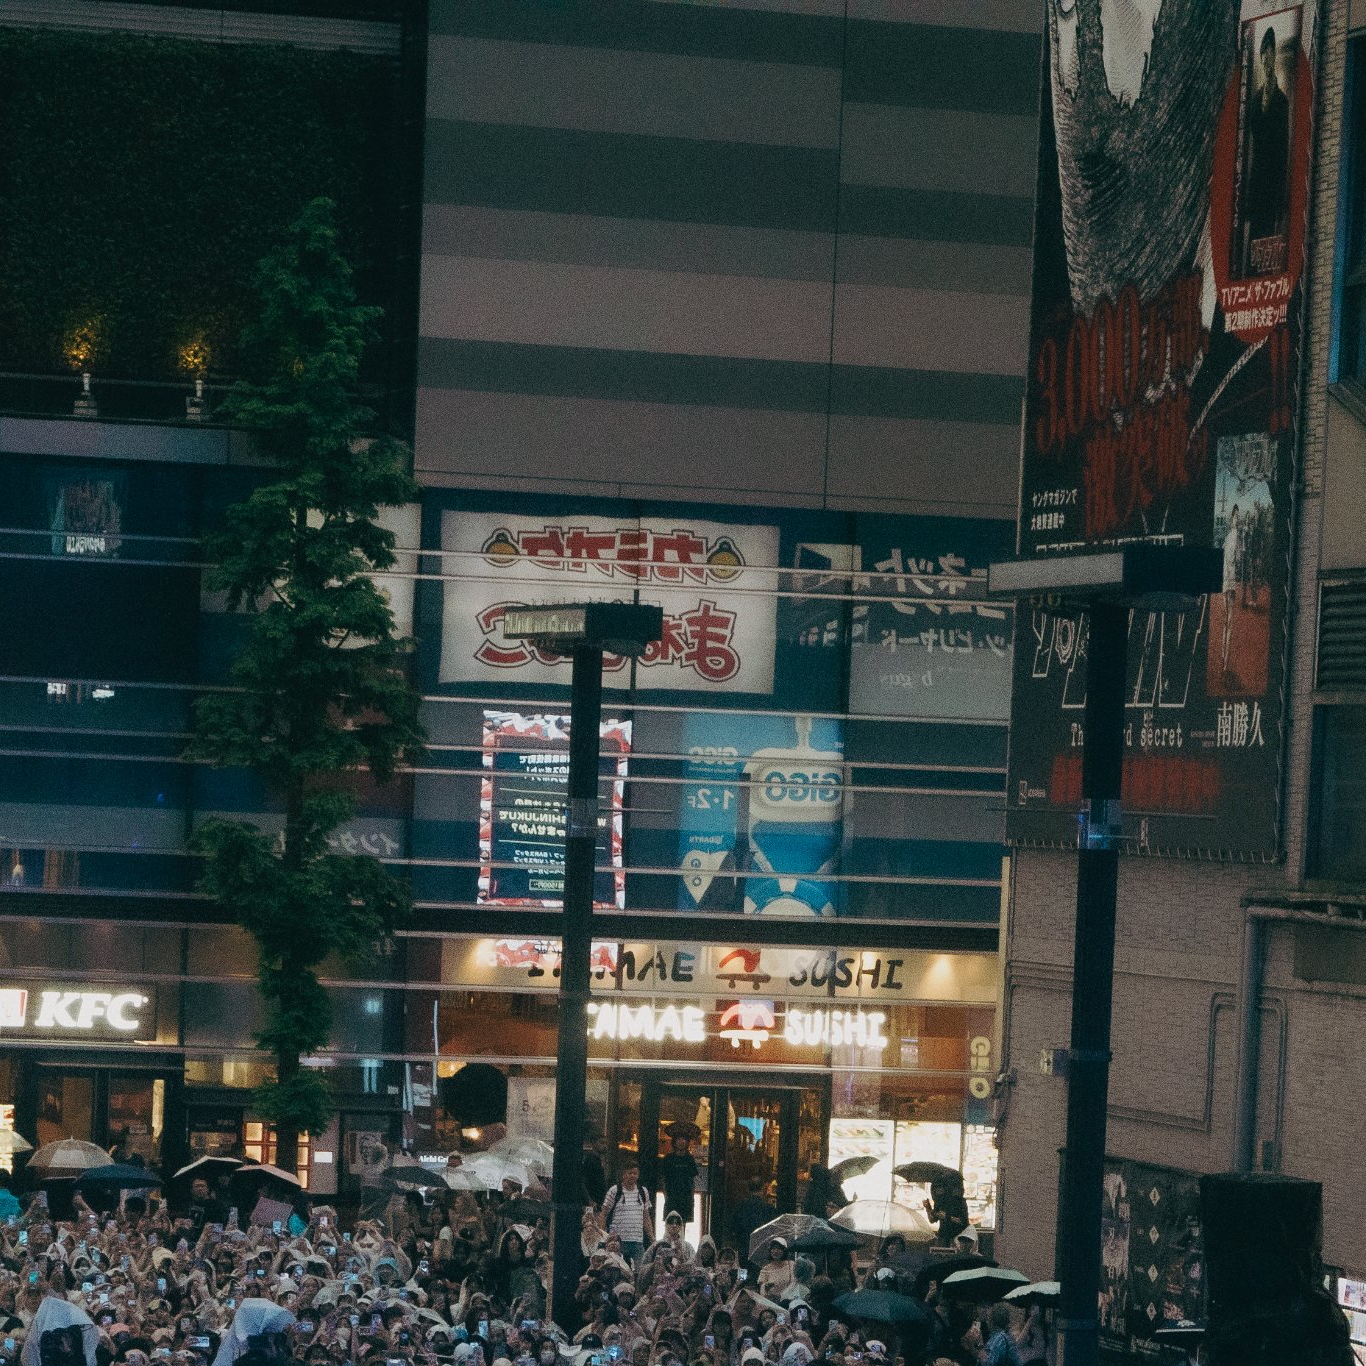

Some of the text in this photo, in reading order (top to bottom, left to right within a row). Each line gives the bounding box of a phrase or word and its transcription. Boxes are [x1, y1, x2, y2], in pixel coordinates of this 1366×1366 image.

[1140, 722, 1183, 748] secret
[1217, 701, 1265, 748] 南勝久
[790, 952, 904, 990] SUSHI
[35, 991, 142, 1031] KFC
[786, 1008, 891, 1049] SUSHI
